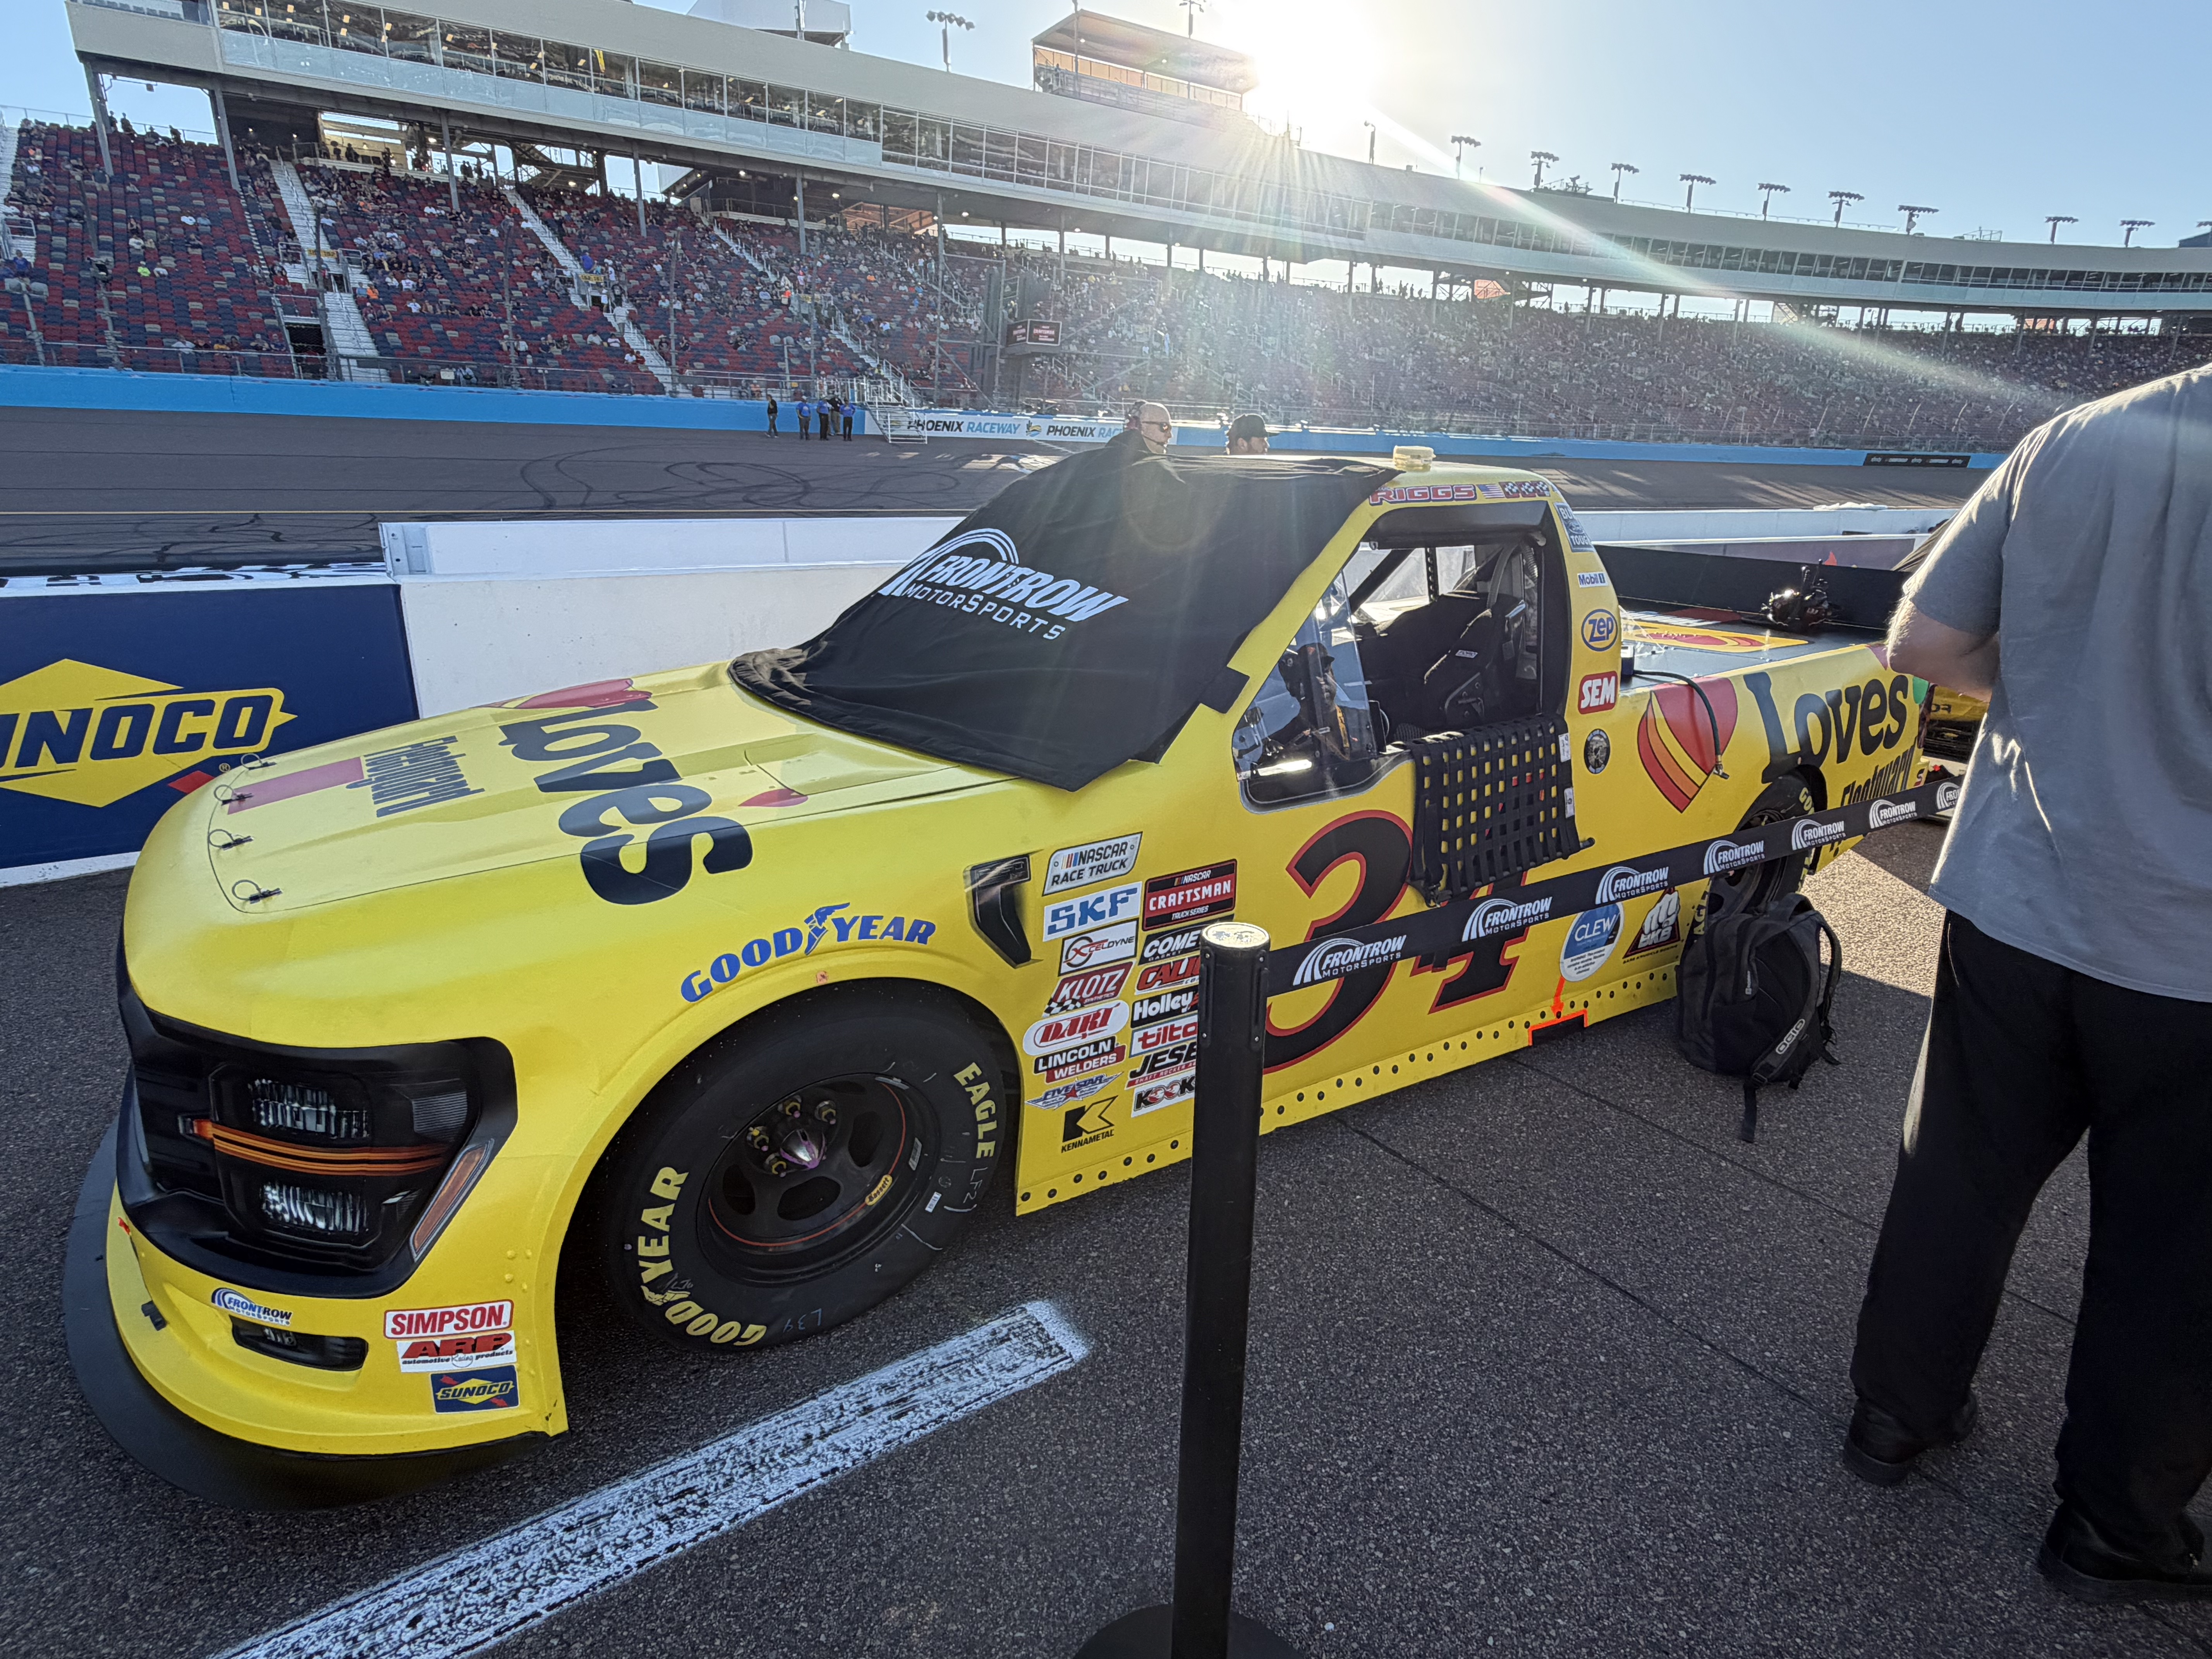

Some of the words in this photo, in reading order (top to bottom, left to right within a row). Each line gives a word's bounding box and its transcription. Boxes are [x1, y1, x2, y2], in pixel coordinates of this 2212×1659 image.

[907, 420, 964, 432] PHOENIX
[967, 422, 1020, 434] RACEWAY
[1046, 426, 1096, 438] PHOENIX
[1369, 485, 1477, 505] RIGGS
[1570, 535, 1590, 546] TOUG
[917, 555, 1129, 623] FRONTROW
[1578, 574, 1599, 585] Mobil
[1580, 676, 1615, 709] SEM
[0, 695, 273, 768] NOCO
[346, 735, 486, 818] Fleetguard
[1880, 801, 1915, 819] FRONTROW
[1804, 821, 1844, 841] FRONTROW
[1078, 841, 1128, 866] NASCAR
[1718, 841, 1764, 864] FRONTROW
[1052, 868, 1085, 886] RACE
[1088, 858, 1128, 876] TRUCK
[1183, 870, 1211, 884] NASCAR
[1614, 867, 1669, 891] FRONTROW
[1149, 880, 1231, 911] CRAFTSMAN
[1048, 888, 1137, 935] SKF
[1171, 911, 1190, 921] TRUCK
[1190, 905, 1209, 917] SERIES
[1485, 896, 1553, 928] FRONTROW
[1575, 914, 1616, 941] CLEW
[1144, 930, 1200, 958] COME
[1322, 935, 1406, 971] FRONTROW
[1058, 969, 1125, 1002] KLOTZ
[1133, 991, 1194, 1021] Holley
[1039, 1003, 1120, 1044] DART
[1138, 1022, 1198, 1049] tilto
[1038, 1039, 1111, 1070] LINCOLN
[1054, 1053, 1116, 1079] WELDERS
[1130, 1042, 1197, 1079] JESE
[1043, 1084, 1072, 1101] FIVE
[1076, 1075, 1103, 1089] STAR
[1135, 1075, 1195, 1110] KOOK
[953, 1062, 998, 1159] EAGLE
[1061, 1129, 1115, 1153] KENNAMETAL
[228, 1297, 292, 1321] FRONTROW
[391, 1305, 504, 1335] SIMPSON
[401, 1333, 512, 1359] ARP
[475, 1350, 513, 1360] products
[440, 1382, 513, 1399] SUNOCO
